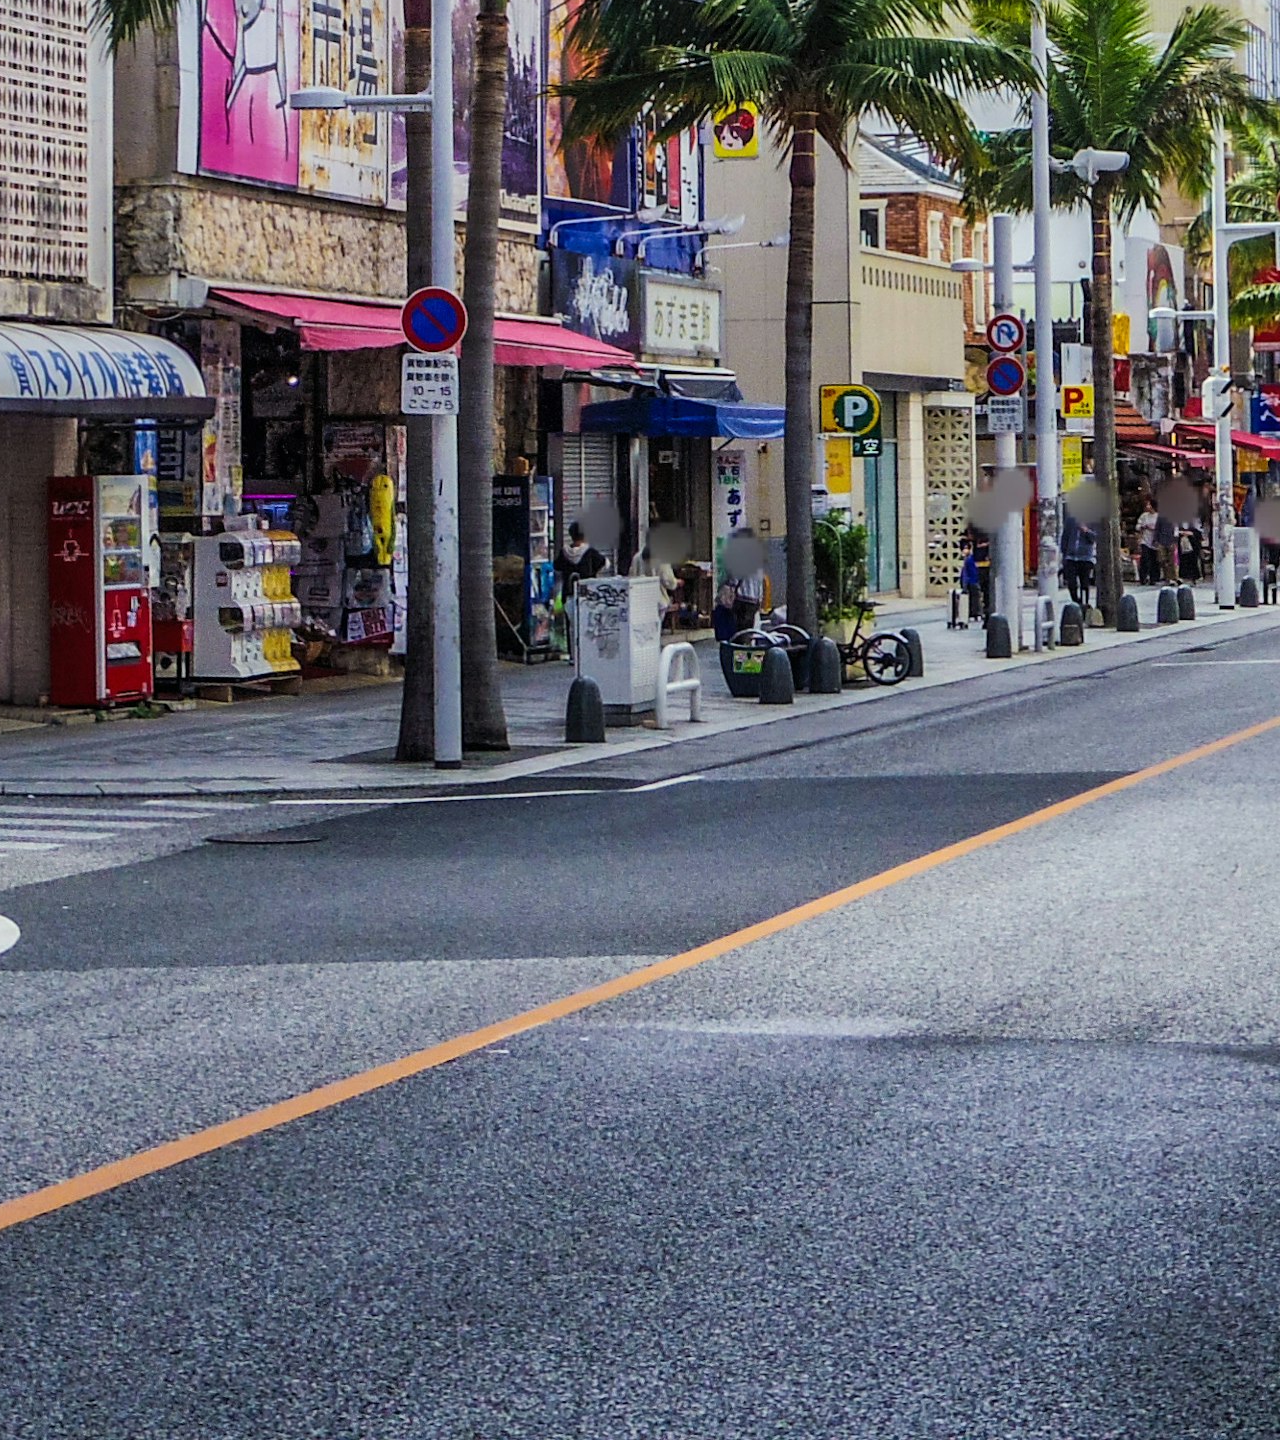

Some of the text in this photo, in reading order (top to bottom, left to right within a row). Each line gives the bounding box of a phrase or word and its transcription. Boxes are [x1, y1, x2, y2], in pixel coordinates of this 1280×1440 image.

[408, 399, 454, 410] ここから
[844, 396, 868, 427] P
[1064, 388, 1083, 414] P
